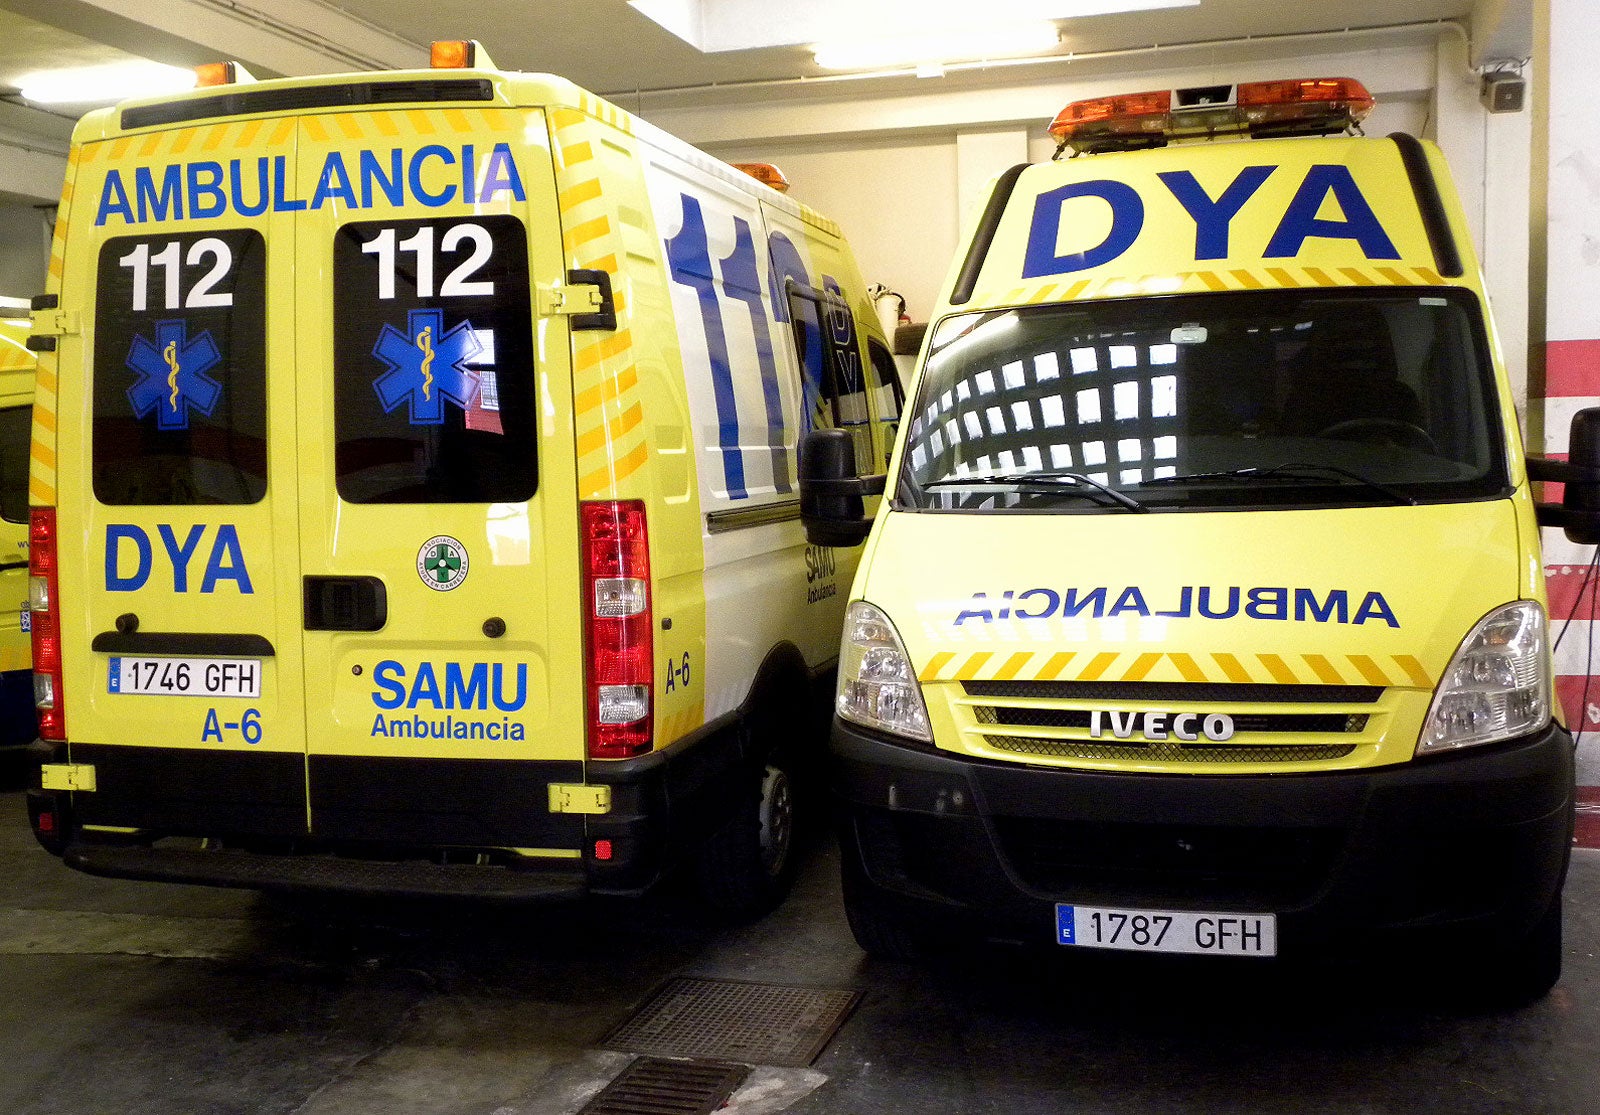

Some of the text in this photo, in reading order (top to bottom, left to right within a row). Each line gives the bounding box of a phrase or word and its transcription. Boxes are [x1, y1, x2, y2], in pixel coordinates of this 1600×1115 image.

[96, 143, 527, 227] AMBULANCIA
[1022, 164, 1401, 279] DYA
[119, 237, 233, 311] 112
[361, 223, 495, 299] 112
[105, 524, 254, 595] DYA
[424, 538, 461, 551] ASOCIACION
[419, 561, 431, 583] AYUDA
[440, 560, 466, 589] CARRETERA
[804, 546, 836, 584] SAMU
[132, 662, 190, 691] 1746
[205, 663, 254, 693] GFH
[371, 660, 528, 712] SAMU
[665, 651, 690, 694] A-6
[201, 708, 263, 745] A-6
[371, 714, 525, 741] Ambulancia
[1090, 711, 1235, 741] IVECO
[1063, 912, 1262, 951] E 1787 GFH
